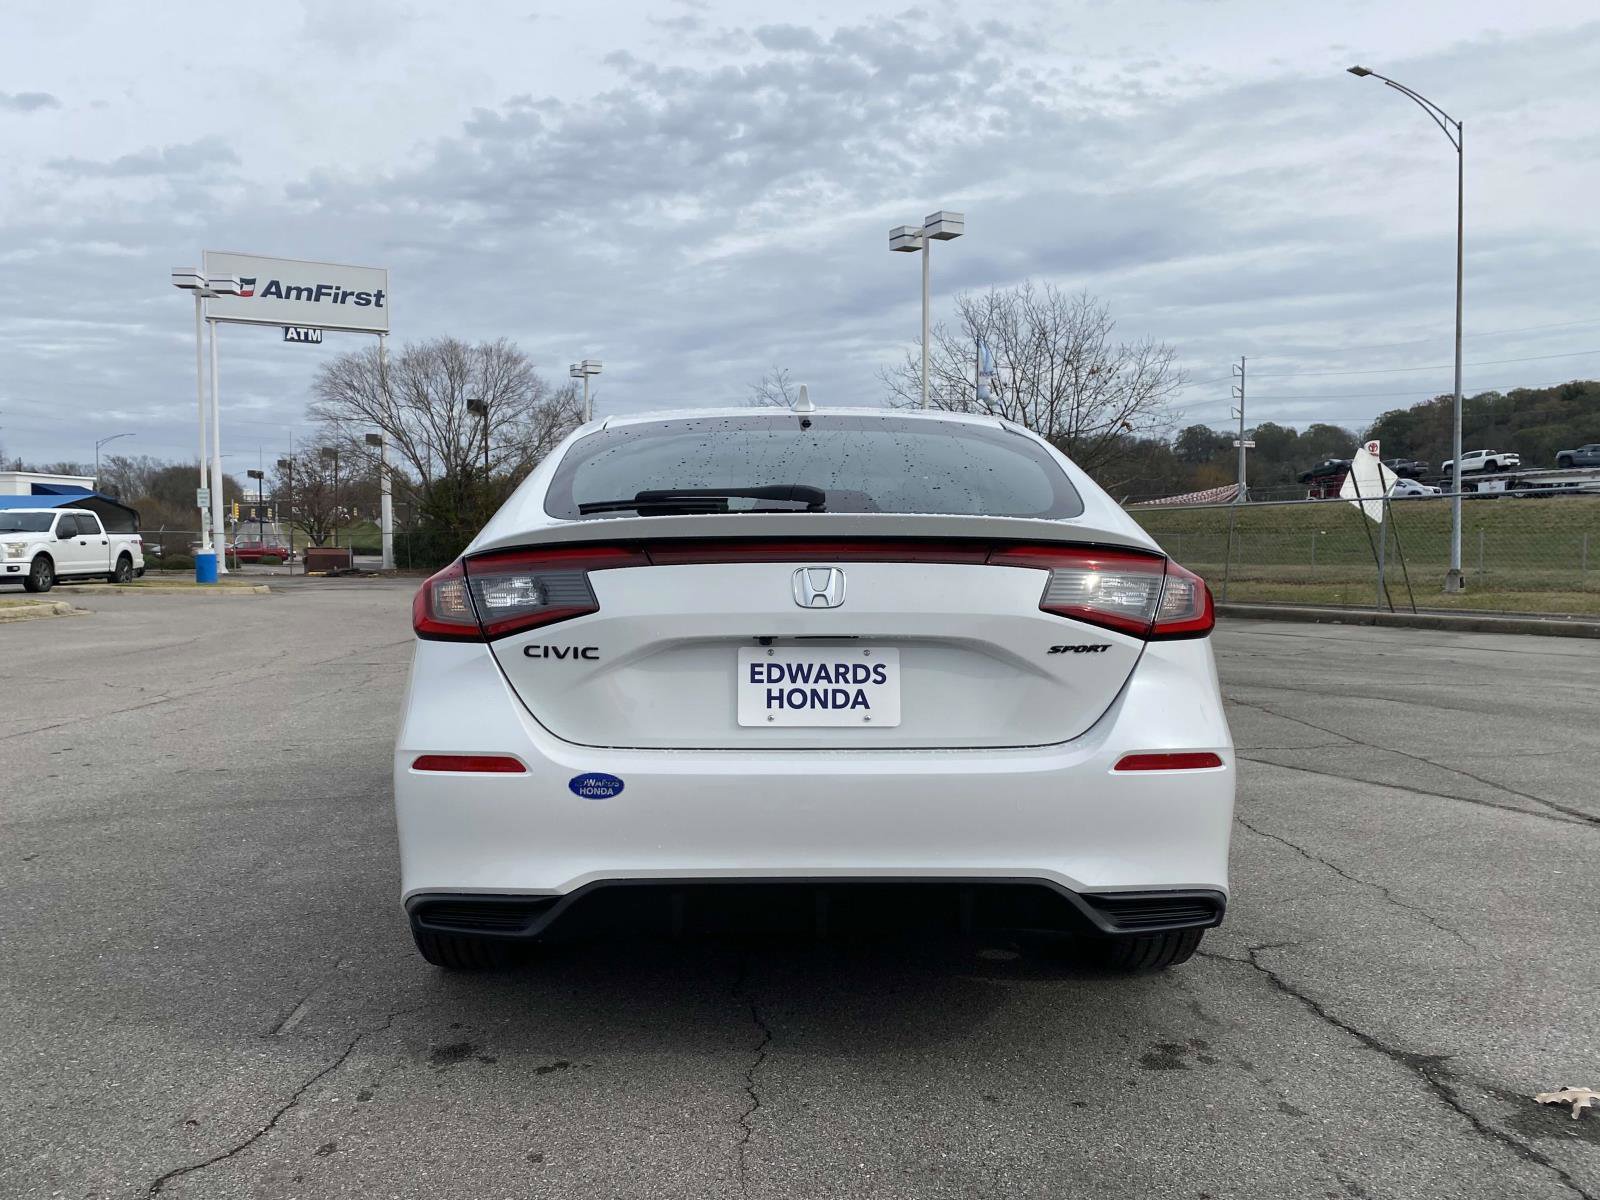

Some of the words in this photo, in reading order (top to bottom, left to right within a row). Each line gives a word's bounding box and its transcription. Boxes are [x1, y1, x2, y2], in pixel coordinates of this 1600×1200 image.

[260, 279, 385, 307] AmFirst
[286, 328, 321, 342] ATM
[523, 645, 600, 660] CIVIC
[1046, 644, 1113, 654] SPORT
[750, 663, 887, 684] EDWARDS
[766, 688, 871, 709] HONDA
[580, 787, 614, 795] HONDA
